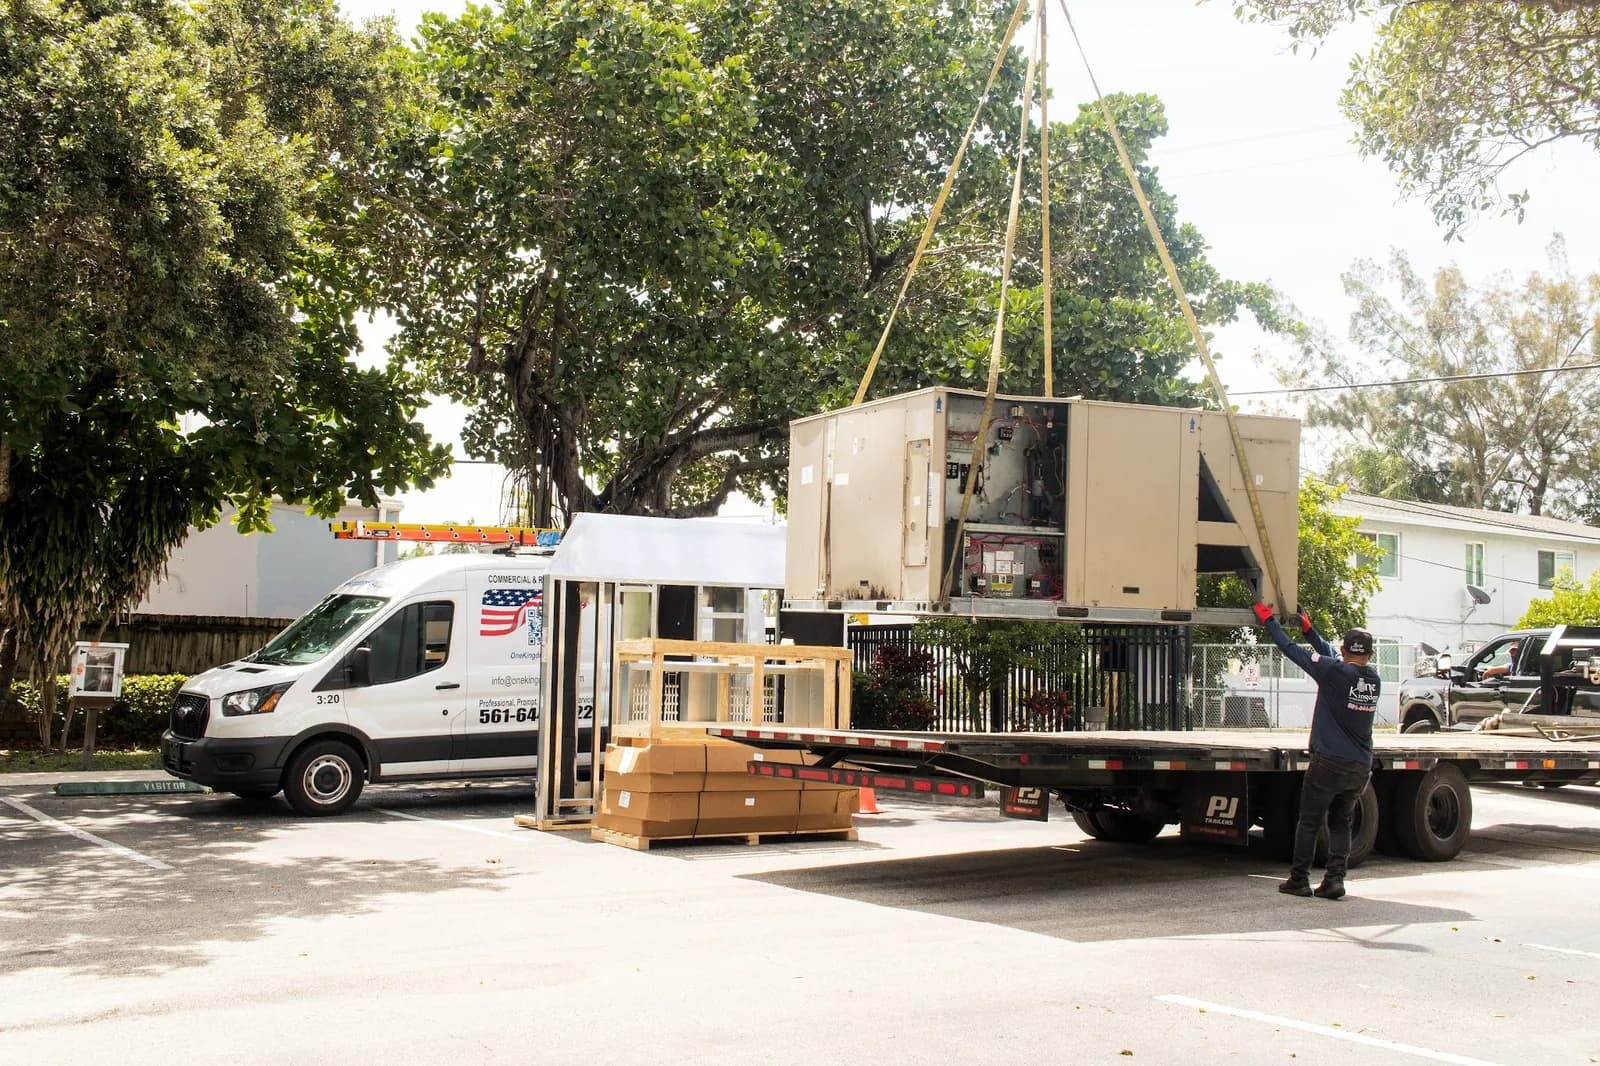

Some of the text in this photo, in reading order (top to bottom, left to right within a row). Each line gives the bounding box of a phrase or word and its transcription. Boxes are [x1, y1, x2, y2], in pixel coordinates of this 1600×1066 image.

[488, 575, 531, 584] COMMERCIAL
[532, 575, 537, 583] &
[317, 694, 340, 704] 3:20
[480, 707, 539, 724] 561-64
[144, 782, 186, 790] VISITOR
[1206, 795, 1239, 818] PJ
